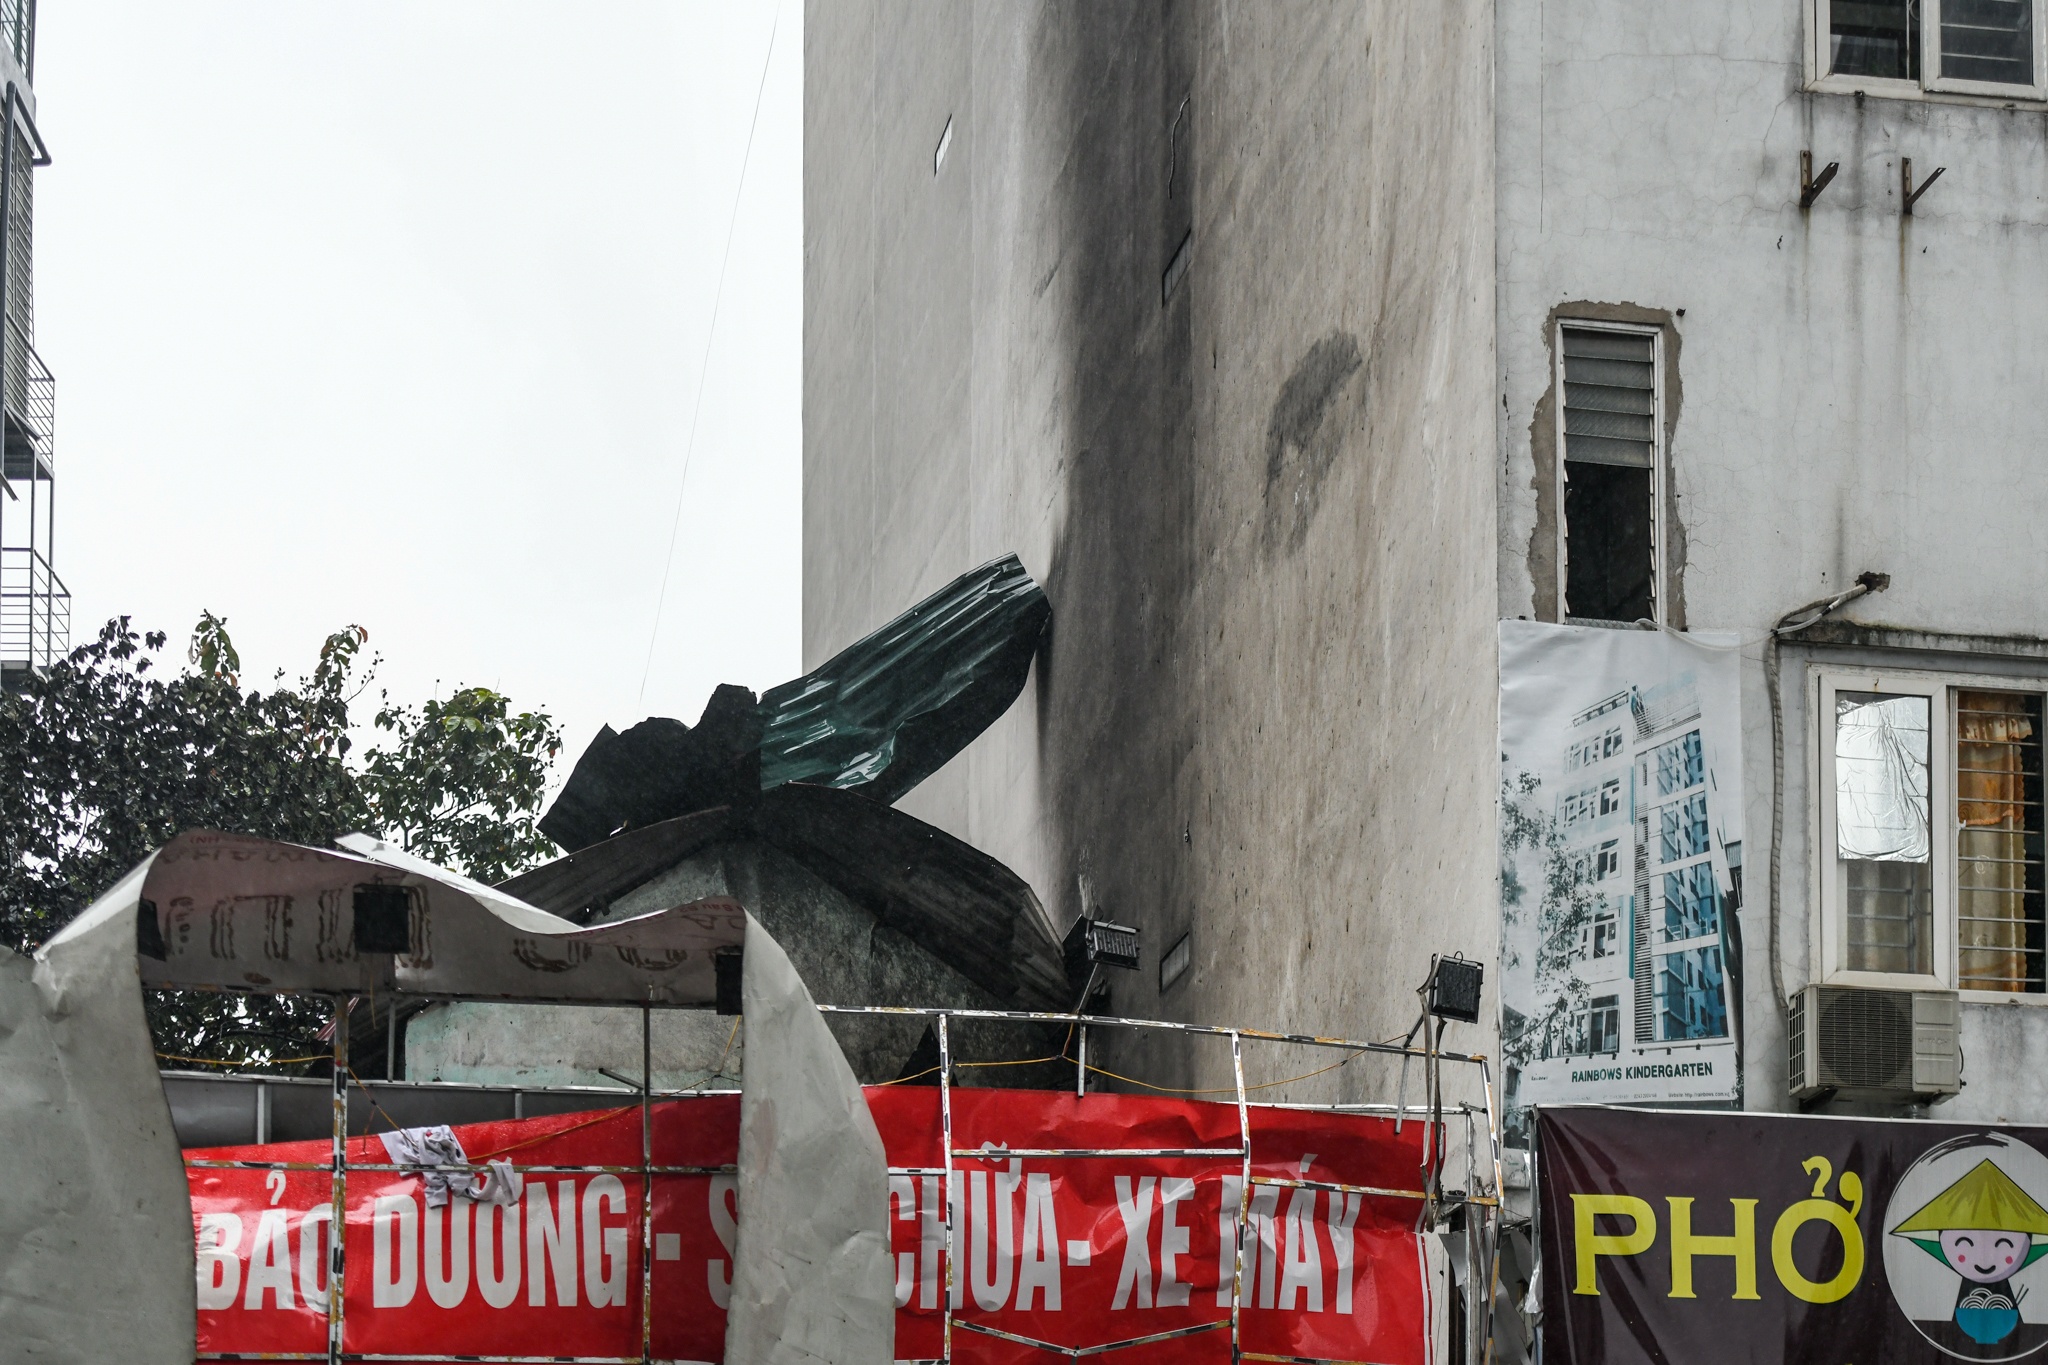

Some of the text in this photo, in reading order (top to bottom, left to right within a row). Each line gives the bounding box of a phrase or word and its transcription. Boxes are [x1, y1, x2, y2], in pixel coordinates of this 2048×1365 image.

[1571, 1062, 1713, 1083] RAINBOWS KINDERGARTEN
[1110, 1174, 1198, 1311] XE
[1216, 1152, 1363, 1315] MÁY
[1569, 1155, 1864, 1304] PHỞ
